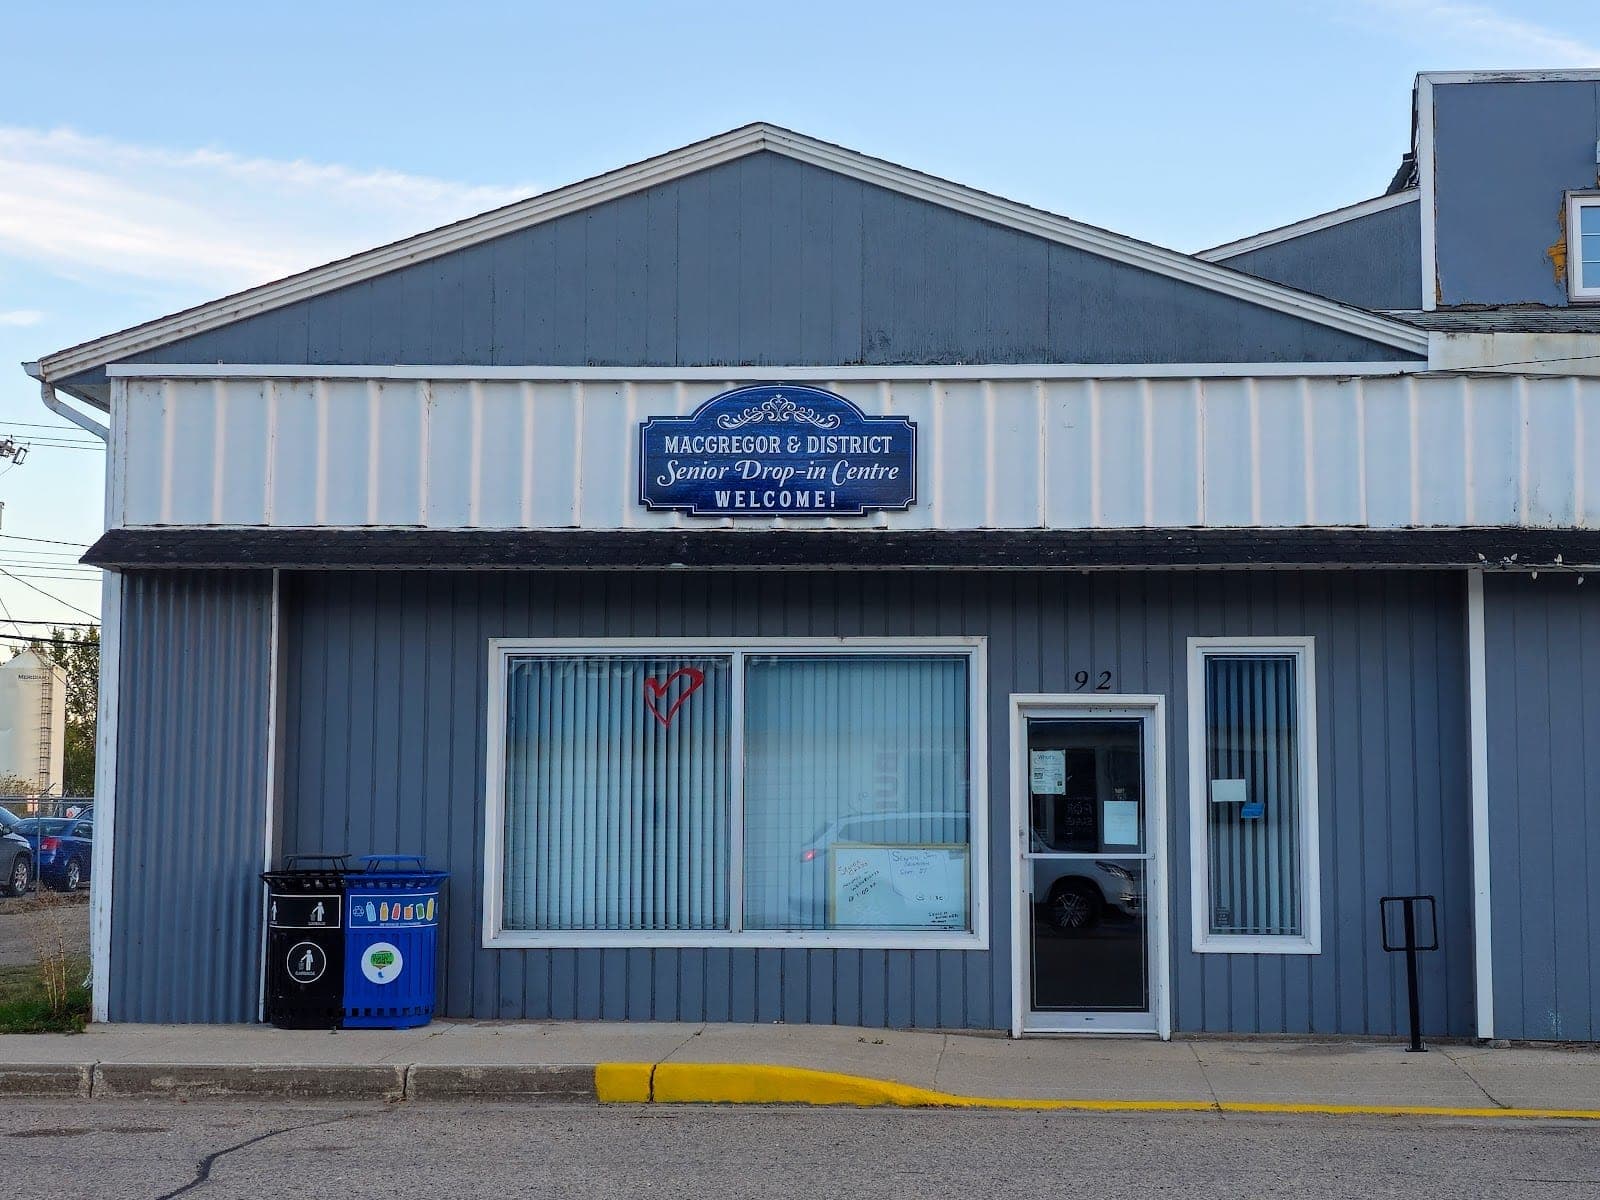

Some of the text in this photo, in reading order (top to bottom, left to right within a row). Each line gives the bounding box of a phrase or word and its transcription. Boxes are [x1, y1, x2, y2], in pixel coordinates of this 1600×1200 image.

[664, 436, 892, 454] MACGREGOR & DISTRICT
[657, 459, 899, 487] Senior Drop-in Centre
[715, 491, 836, 508] WELCOME!
[1074, 671, 1112, 690] 92
